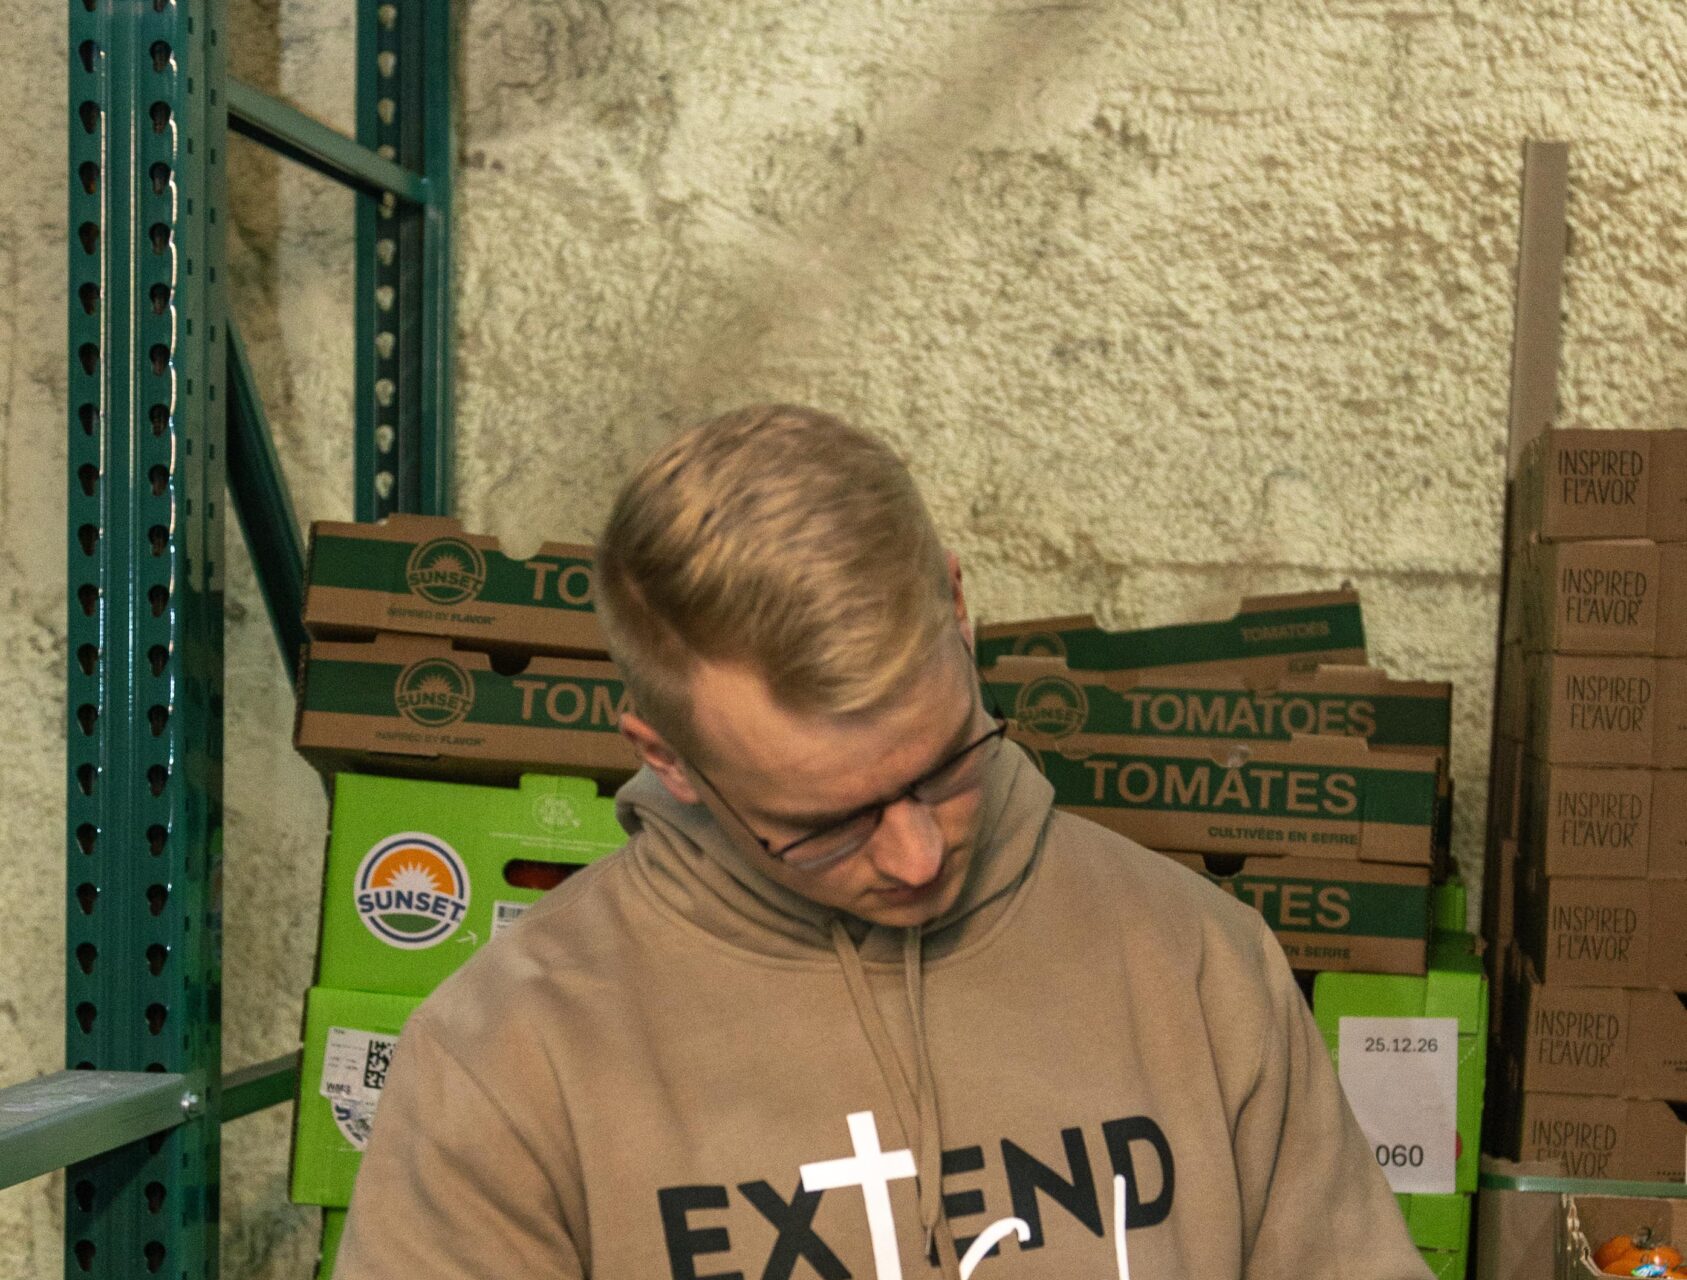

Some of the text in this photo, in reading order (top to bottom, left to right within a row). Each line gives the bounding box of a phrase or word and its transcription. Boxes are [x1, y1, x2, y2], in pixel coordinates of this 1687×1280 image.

[1558, 450, 1643, 476] INSPIRED
[409, 568, 483, 593] SUNSET
[1562, 568, 1647, 597] INSPIRED
[397, 690, 471, 713] SUNSET
[1566, 675, 1651, 704] INSPIRED
[1123, 692, 1376, 738] TOMATOES
[1557, 791, 1642, 820] INSPIRED
[1288, 830, 1307, 842] EN
[1311, 832, 1359, 845] SERRE
[358, 890, 466, 921] SUNSET
[1552, 906, 1637, 934] INSPIRED
[1535, 1009, 1619, 1040] INSPIRED
[1365, 1037, 1438, 1053] 25.12.26
[1532, 1121, 1617, 1151] INSPIRED
[1375, 1144, 1424, 1168] 060
